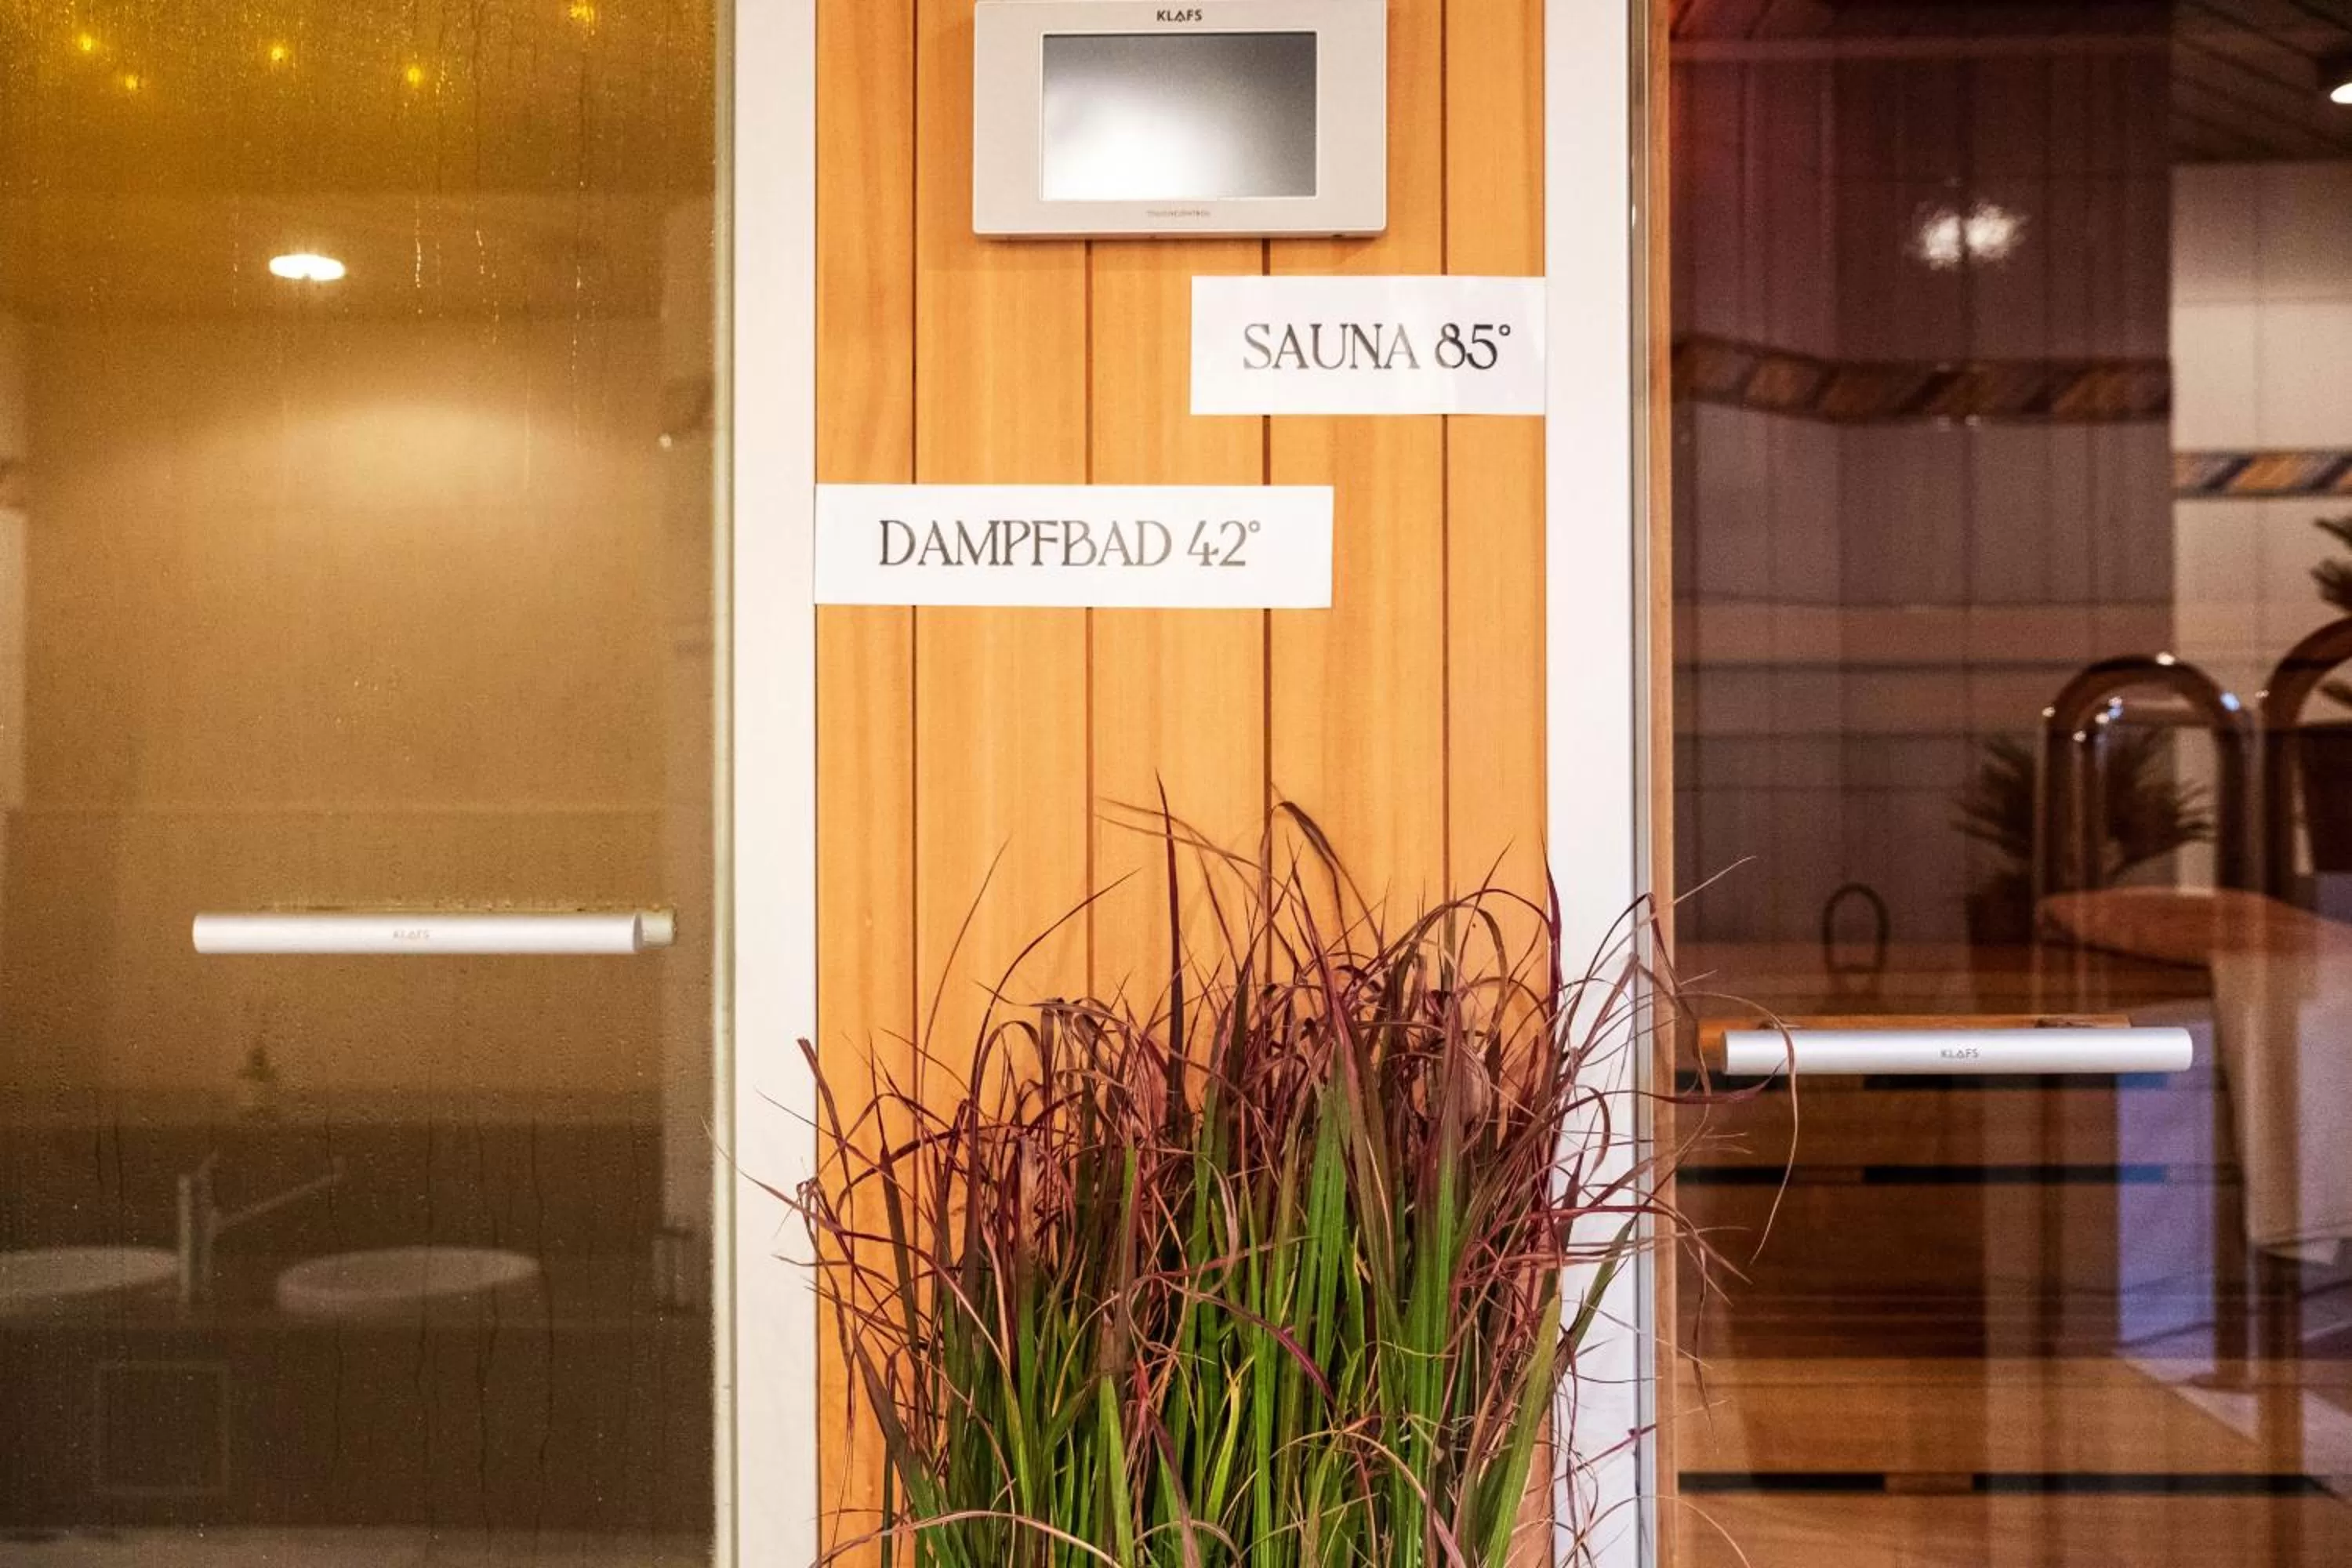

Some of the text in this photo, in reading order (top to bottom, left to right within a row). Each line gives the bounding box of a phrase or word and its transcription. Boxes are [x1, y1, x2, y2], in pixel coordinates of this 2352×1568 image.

[1156, 9, 1202, 22] KLAFS
[1243, 322, 1512, 370] SAUNA 85°
[879, 520, 1261, 566] DAMPFBAD 42°
[1940, 1048, 1979, 1058] KLAFS
